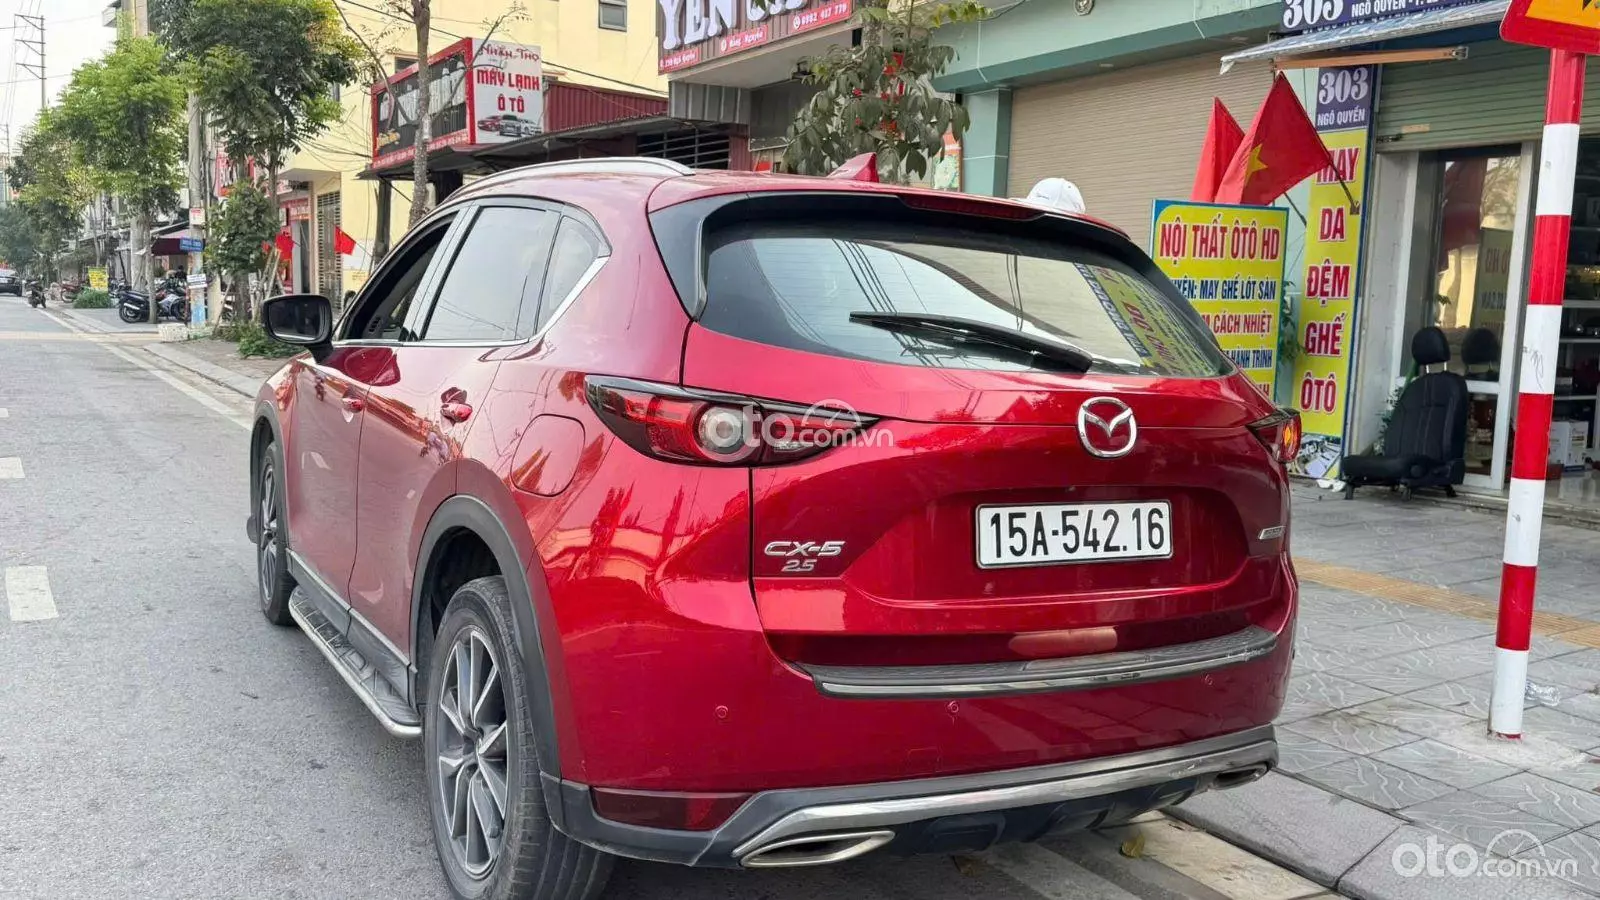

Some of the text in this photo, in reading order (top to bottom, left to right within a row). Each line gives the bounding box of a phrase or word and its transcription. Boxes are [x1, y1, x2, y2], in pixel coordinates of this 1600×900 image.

[507, 72, 540, 92] LẠNH
[1318, 67, 1368, 104] 303
[497, 93, 525, 114] Ô TÔ
[1317, 109, 1335, 126] NGÔ
[1159, 213, 1281, 265] NỘI THẤT ÔTÔ HD
[1319, 206, 1346, 241] DA
[1199, 279, 1220, 300] MAY
[1221, 273, 1241, 300] GHẾ
[1306, 257, 1351, 305] ĐỆM
[1213, 310, 1241, 335] CÁCH
[1243, 310, 1273, 338] NHIỆT
[1304, 312, 1346, 356] GHẾ
[1300, 372, 1337, 413] ÔTÔ
[764, 541, 846, 557] CX-5
[991, 508, 1165, 559] 15A-542.16
